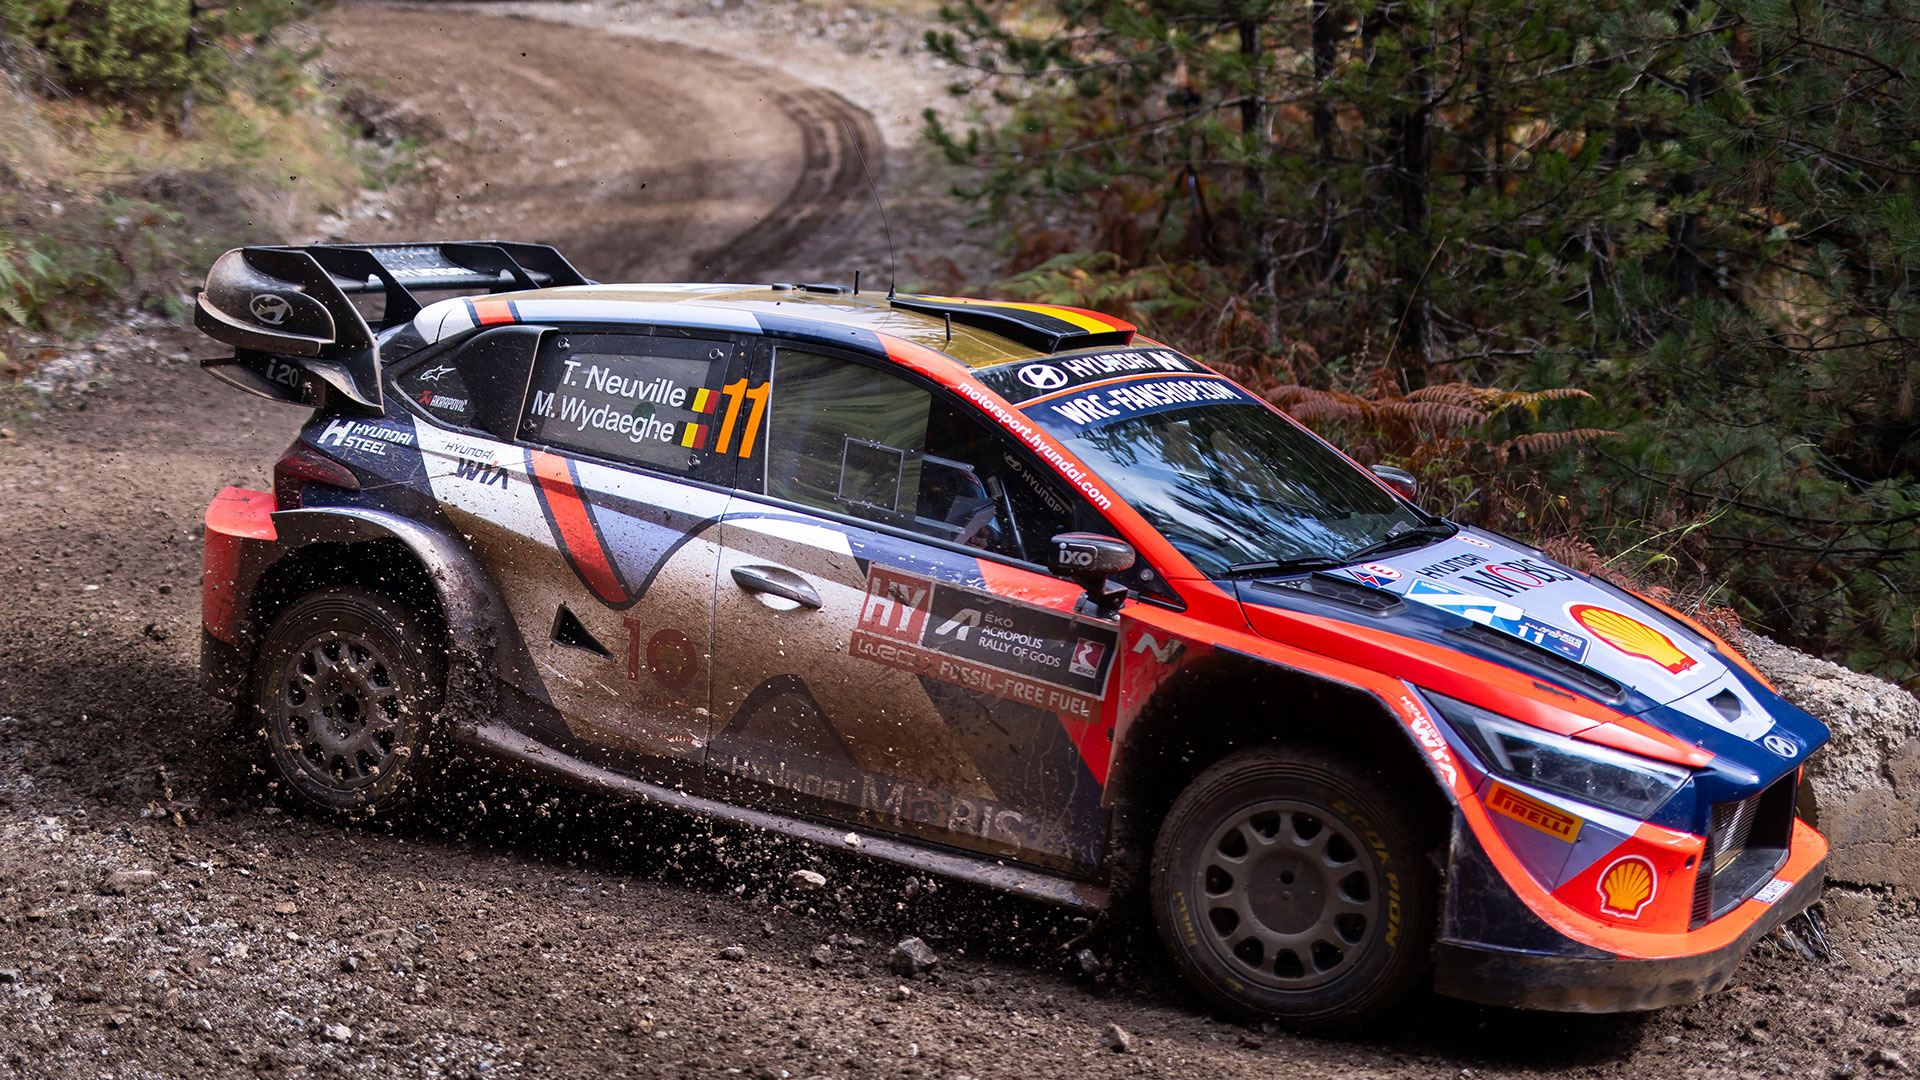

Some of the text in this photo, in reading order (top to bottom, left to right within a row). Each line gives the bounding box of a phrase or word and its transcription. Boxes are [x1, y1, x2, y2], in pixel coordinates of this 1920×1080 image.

[266, 358, 298, 388] i20
[1061, 352, 1157, 378] HYUNDAI
[562, 359, 686, 408] T. Neuville
[531, 389, 675, 443] M. Wydaeghe
[715, 377, 771, 459] 11
[1050, 380, 1242, 425] WRC-FANSHOP.COM
[343, 436, 386, 456] STEEL
[351, 421, 414, 445] HYUNDAI
[957, 381, 1112, 511] motorsport.hyundai.com
[445, 442, 494, 460] HYUNDAI
[1415, 552, 1490, 580] HYUNDAI
[1459, 558, 1574, 598] MOBIS
[981, 625, 1043, 649] ACROPOLIS
[1518, 624, 1545, 645] 11
[623, 617, 698, 689] 10
[978, 636, 1062, 668] RALLY OF GODS
[1047, 691, 1092, 718] FUEL
[1494, 786, 1575, 836] PIRELLI
